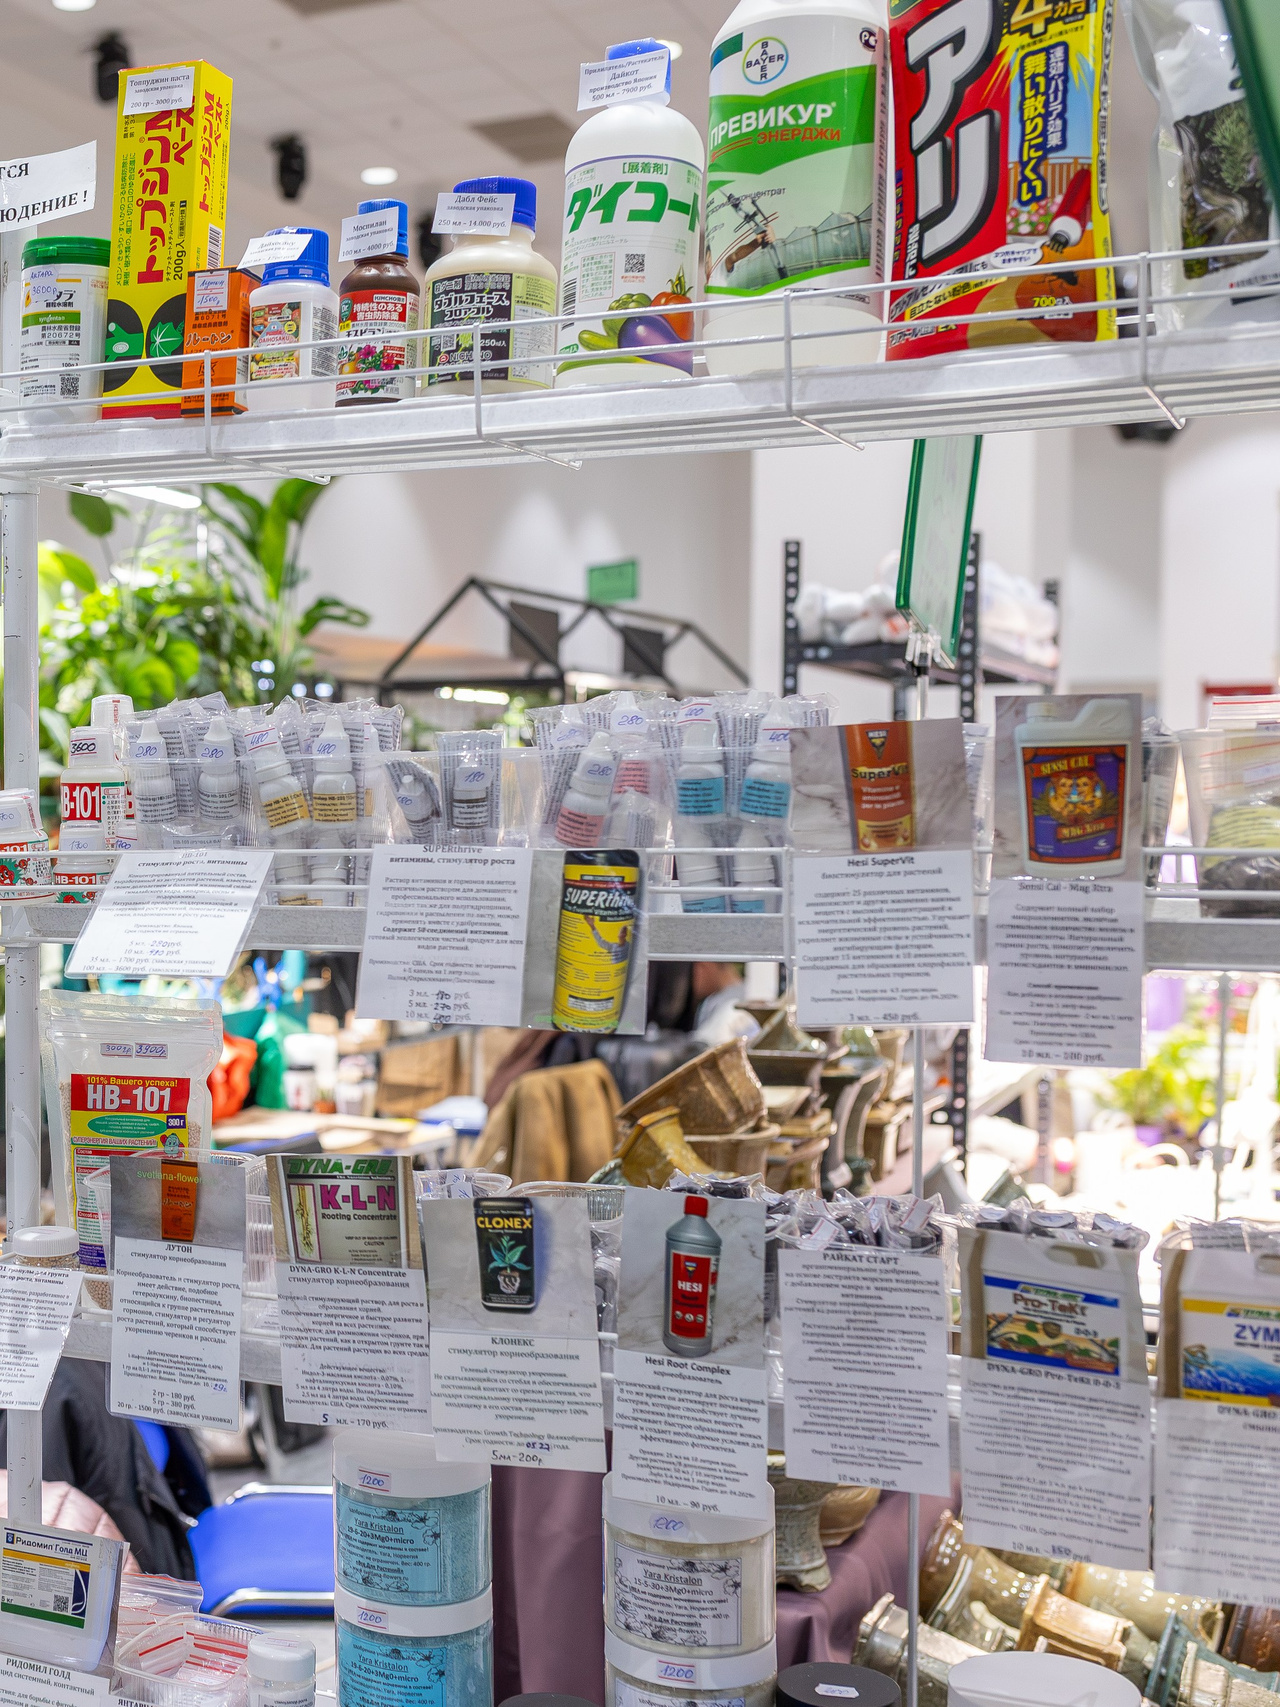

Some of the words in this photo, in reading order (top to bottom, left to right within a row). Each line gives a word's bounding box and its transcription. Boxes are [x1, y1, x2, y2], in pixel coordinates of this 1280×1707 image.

[745, 54, 785, 69] BAYER
[130, 76, 169, 88] Топпуджин
[170, 74, 190, 82] паста
[610, 67, 639, 82] Дайкот
[589, 79, 632, 94] производство
[710, 103, 833, 150] ПРЕВИКУР
[907, 0, 1001, 267] アリ
[1022, 54, 1047, 203] 舞い散りにくい
[756, 127, 841, 144] ЭНЕРДЖИ
[455, 194, 474, 205] Дабл
[476, 205, 504, 214] упаковка
[352, 218, 387, 233] Моспилан
[438, 219, 449, 227] 250
[468, 219, 490, 228] 14.000
[492, 221, 507, 230] руб.
[366, 243, 381, 252] 4000
[173, 238, 187, 281] 200g入
[353, 303, 403, 313] 持続性のある
[617, 714, 644, 726] 280
[250, 731, 269, 746] 480
[71, 741, 97, 753] 3600
[135, 745, 158, 758] 280
[201, 748, 224, 759] 280
[317, 742, 337, 756] 480
[587, 764, 612, 776] 280
[852, 766, 910, 781] SuperVit
[422, 845, 483, 854] SUPERthrive
[389, 857, 436, 866] витамины,
[437, 857, 490, 867] стимулятор
[491, 858, 515, 867] роста
[847, 857, 869, 867] Hesi
[871, 856, 915, 868] SuperVit
[55, 875, 97, 885] HB-101
[86, 1076, 108, 1085] 101%
[109, 1077, 143, 1086] Вашего
[144, 1079, 178, 1088] успеха!
[86, 1084, 171, 1112] HB-101
[287, 1157, 392, 1175] DYNA-GRO
[319, 1184, 396, 1211] K-L-N
[321, 1212, 351, 1222] Rooting
[353, 1213, 397, 1221] Concentrate
[476, 1216, 533, 1230] CLONEX
[165, 1243, 193, 1254] ЛУТОН
[130, 1251, 167, 1262] стимулятор
[168, 1255, 227, 1269] корнеобразования
[822, 1252, 864, 1264] РАЙКАТ
[866, 1255, 900, 1266] СТАРТ
[116, 1268, 177, 1283] Корнеобразователь
[183, 1277, 221, 1288] стимулятор
[289, 1265, 332, 1275] DYNA-GRO
[357, 1268, 407, 1279] Concentrate
[288, 1276, 335, 1287] стимулятор
[336, 1279, 410, 1289] корнеобразования
[677, 1281, 703, 1293] HESI
[491, 1336, 535, 1347] КЛОНЕКС
[448, 1346, 498, 1358] стимулятор
[499, 1350, 580, 1362] корнеобразования
[691, 1362, 731, 1377] Complex
[653, 1369, 723, 1386] корнеобразователь
[360, 1473, 385, 1487] 1200
[354, 1518, 369, 1528] Yara
[370, 1521, 404, 1534] Kristalon
[15, 1537, 54, 1551] Ридомил
[54, 1543, 73, 1554] Голд
[74, 1547, 89, 1558] МЦ
[643, 1568, 662, 1580] Yara
[663, 1573, 703, 1586] Kristalon
[358, 1609, 383, 1624] 1200
[6, 1657, 46, 1676] РИДОМИЛ
[47, 1666, 71, 1681] ГОЛД
[358, 1653, 373, 1664] Yara
[374, 1657, 409, 1671] Kristalon
[660, 1664, 694, 1679] 1200
[13, 1671, 50, 1686] системный,
[52, 1679, 95, 1696] контактный
